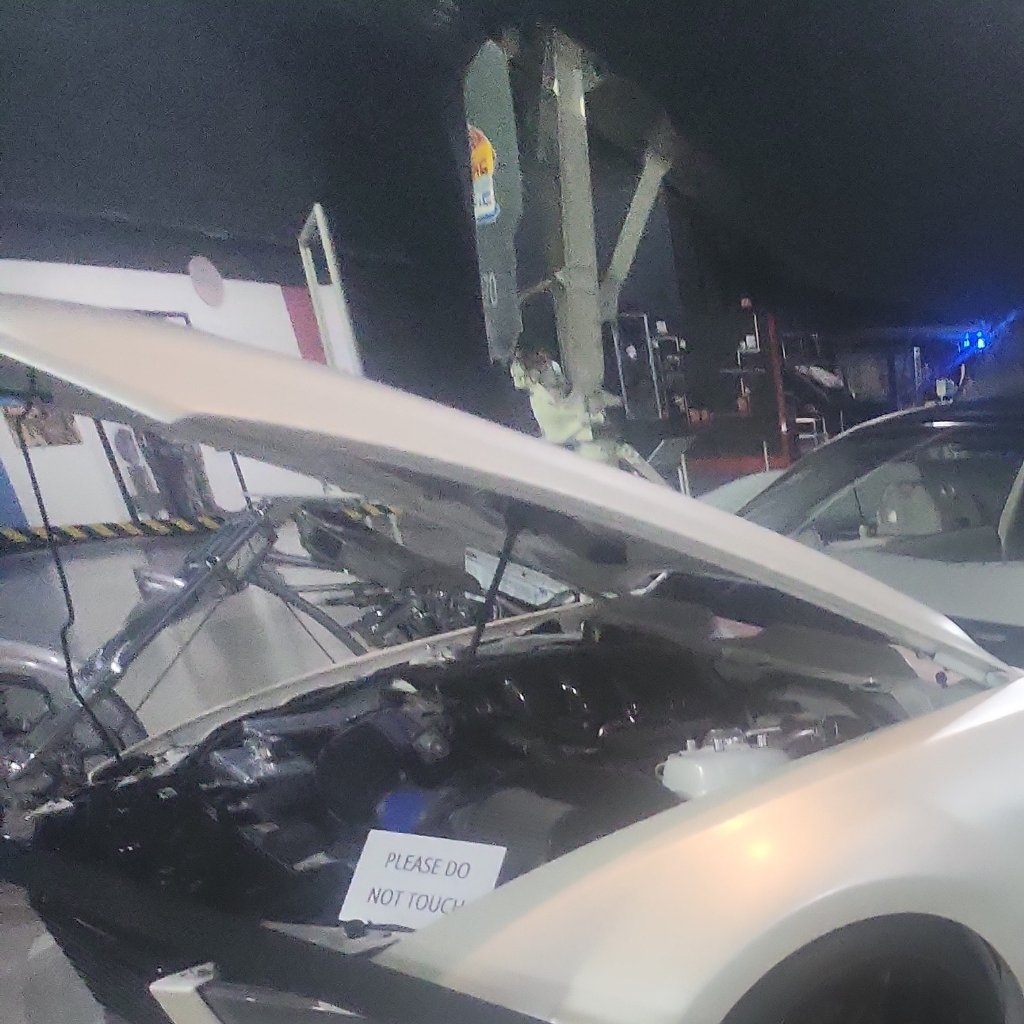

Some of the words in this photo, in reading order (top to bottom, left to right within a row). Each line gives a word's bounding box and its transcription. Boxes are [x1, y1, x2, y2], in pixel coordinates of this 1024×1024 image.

[385, 852, 442, 875] PLEASE
[445, 860, 471, 879] DO
[367, 887, 404, 907] NOT
